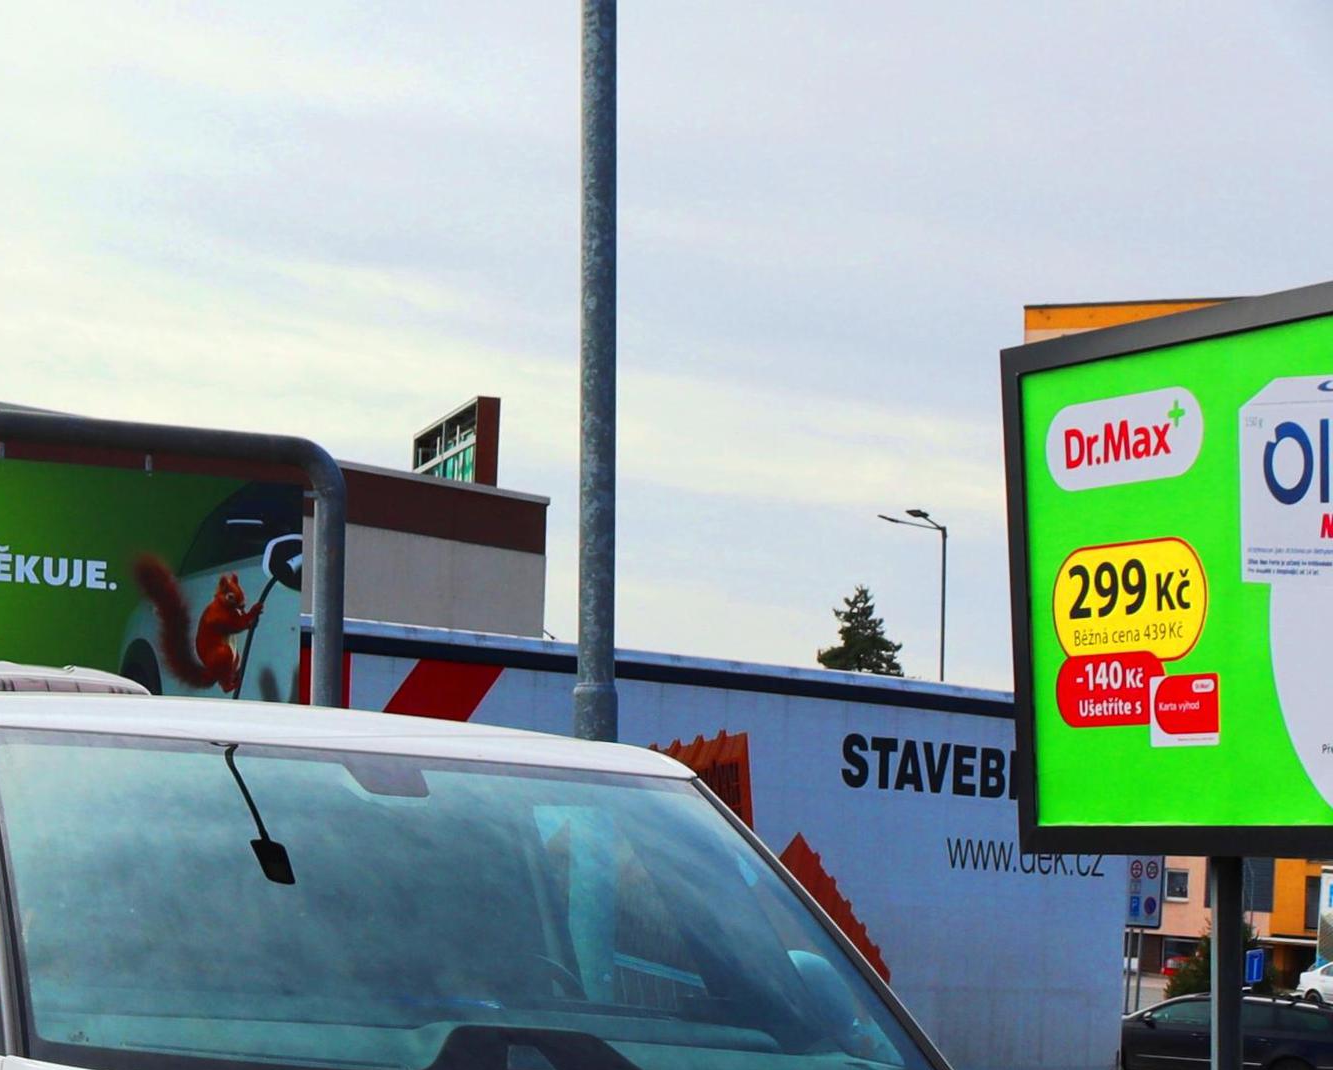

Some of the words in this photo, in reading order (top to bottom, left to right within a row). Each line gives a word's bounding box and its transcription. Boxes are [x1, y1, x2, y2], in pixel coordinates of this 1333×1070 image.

[1068, 558, 1148, 621] 299
[1156, 568, 1191, 613] Kč
[1074, 628, 1108, 648] Běžná
[1112, 629, 1141, 645] cena
[1144, 623, 1166, 642] 439
[1168, 620, 1184, 639] Kč
[1076, 659, 1123, 693] -140
[1125, 667, 1144, 689] Kč
[1079, 695, 1130, 717] Ušetříte
[1135, 701, 1142, 715] s
